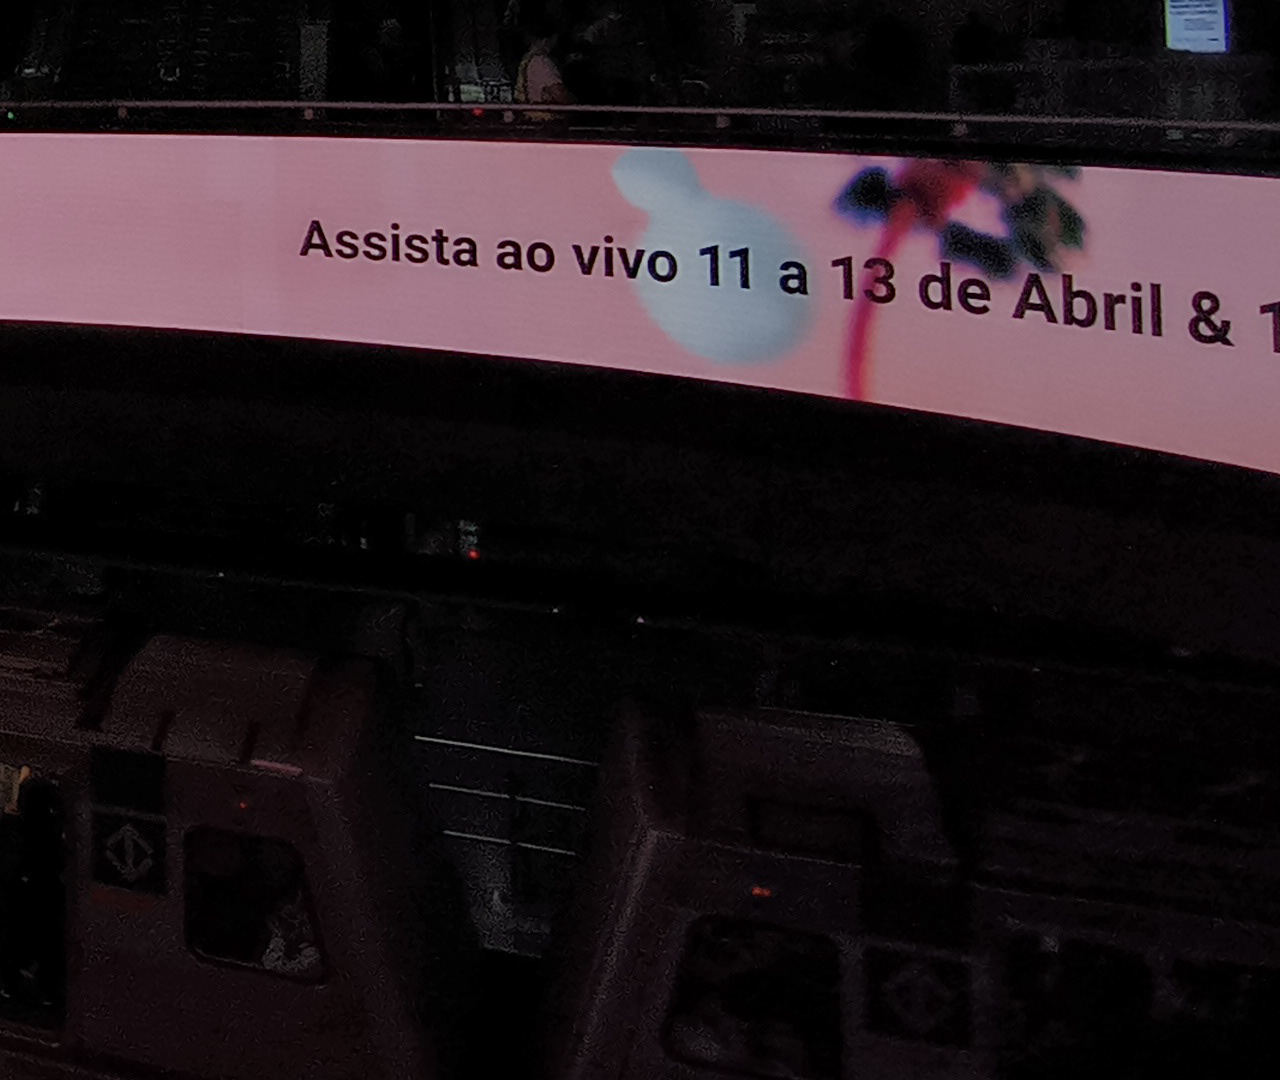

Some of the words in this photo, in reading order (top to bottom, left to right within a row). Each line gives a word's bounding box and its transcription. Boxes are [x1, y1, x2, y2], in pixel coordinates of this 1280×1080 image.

[300, 220, 477, 267] Assista
[496, 239, 555, 273] ao
[573, 235, 678, 283] vivo
[699, 245, 751, 289] 11
[779, 260, 808, 295] a
[832, 256, 896, 304] 13
[919, 262, 991, 314] de
[1013, 273, 1163, 337] Abril
[1188, 291, 1235, 347] &
